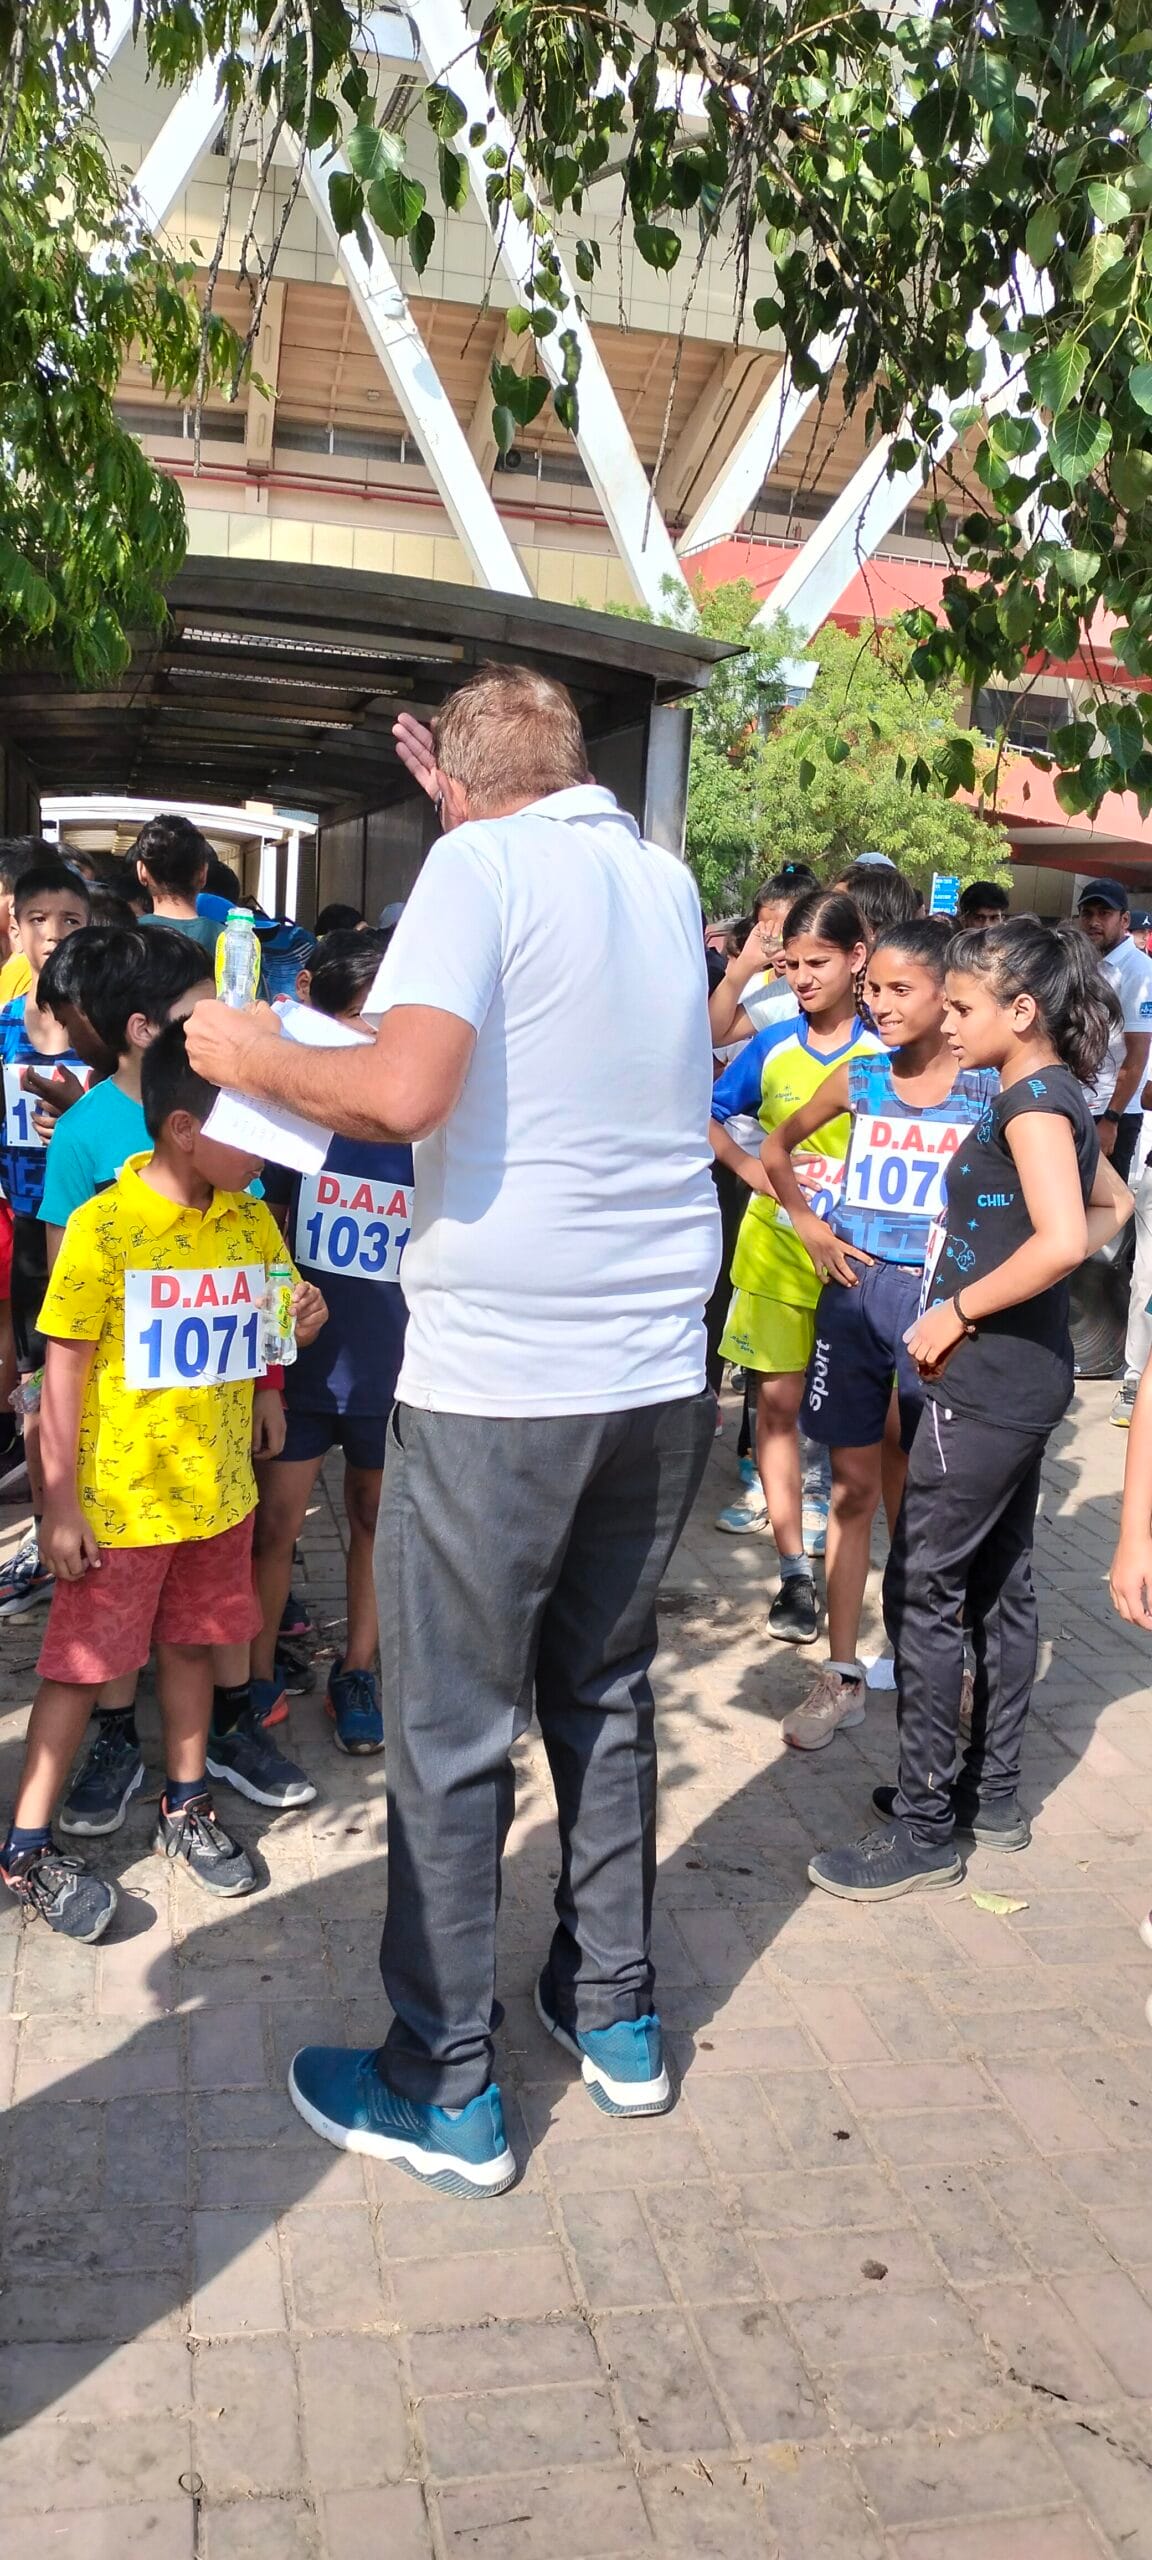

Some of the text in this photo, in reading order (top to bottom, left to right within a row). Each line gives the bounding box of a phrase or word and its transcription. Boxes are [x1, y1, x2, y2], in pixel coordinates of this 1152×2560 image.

[870, 1120, 959, 1154] D.A.A
[317, 1175, 407, 1218] D.A.A
[855, 1154, 949, 1207] 107
[306, 1211, 411, 1275] 1031
[151, 1271, 251, 1309] D.A.A
[139, 1312, 258, 1378] 1071
[809, 1339, 832, 1411] sport
